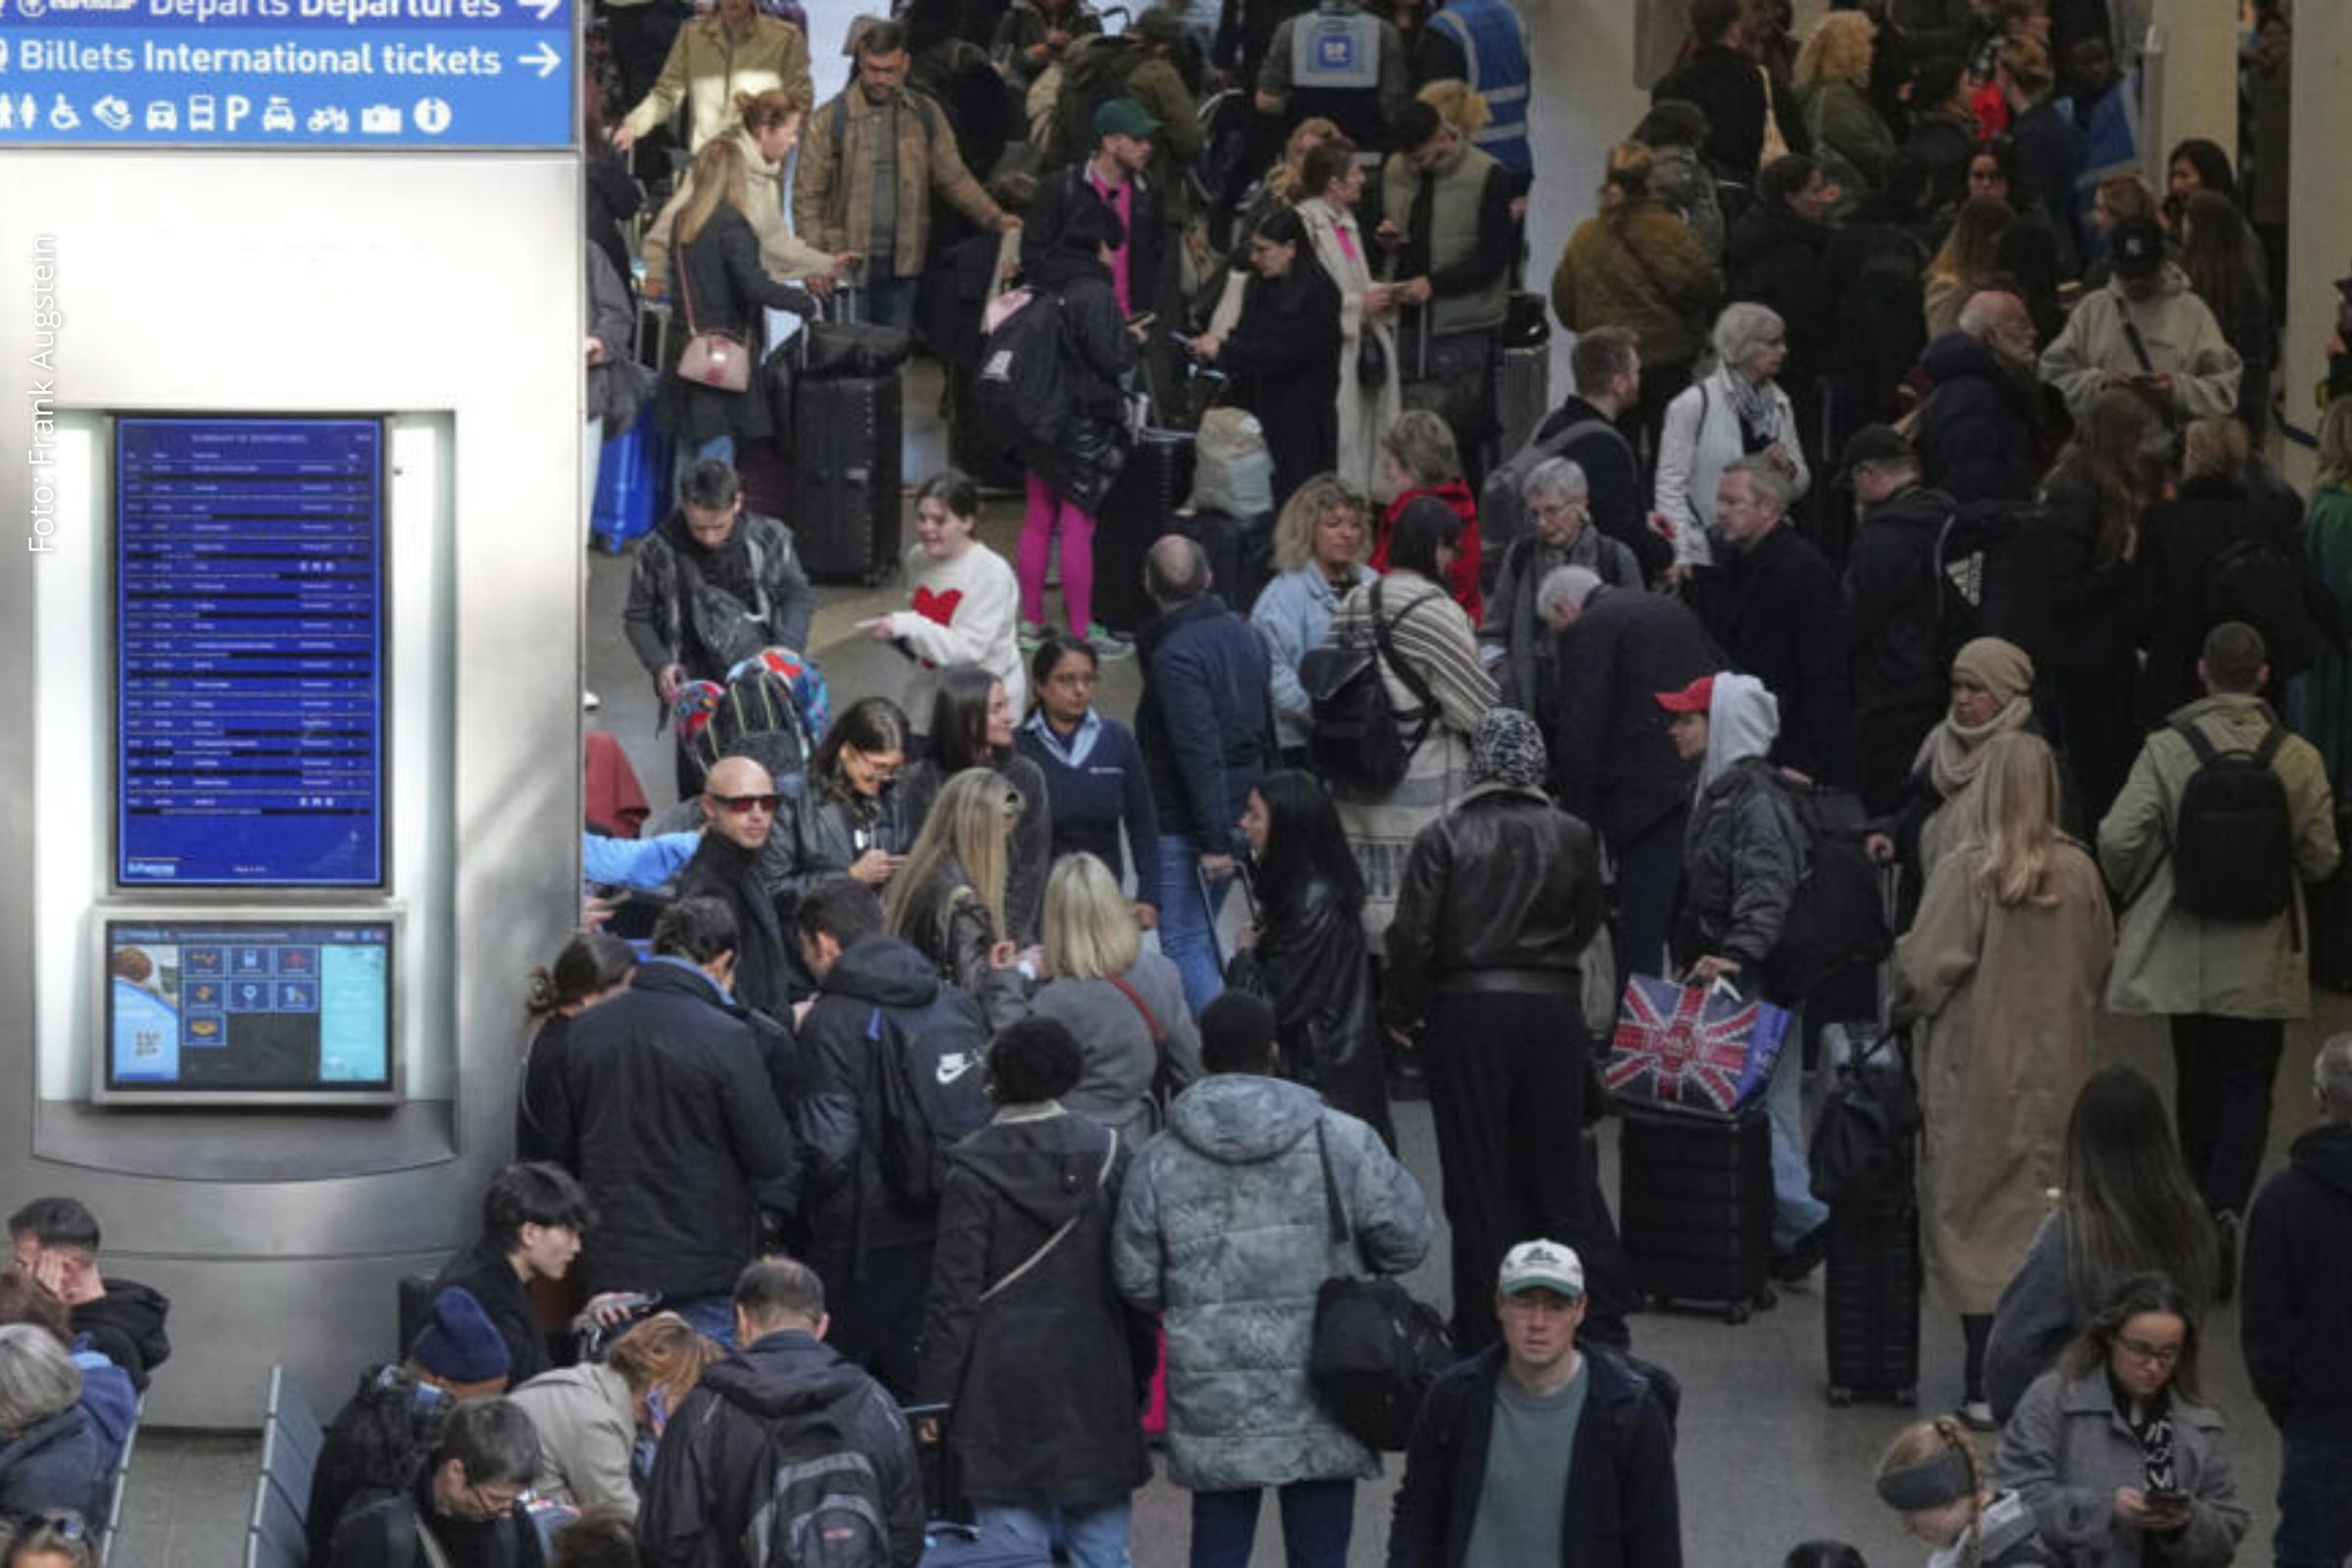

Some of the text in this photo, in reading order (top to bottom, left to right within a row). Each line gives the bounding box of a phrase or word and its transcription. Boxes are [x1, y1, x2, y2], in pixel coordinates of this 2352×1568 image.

[150, 0, 290, 24] Departs
[301, 0, 502, 24] Departures
[20, 40, 502, 74] Billets International tickets
